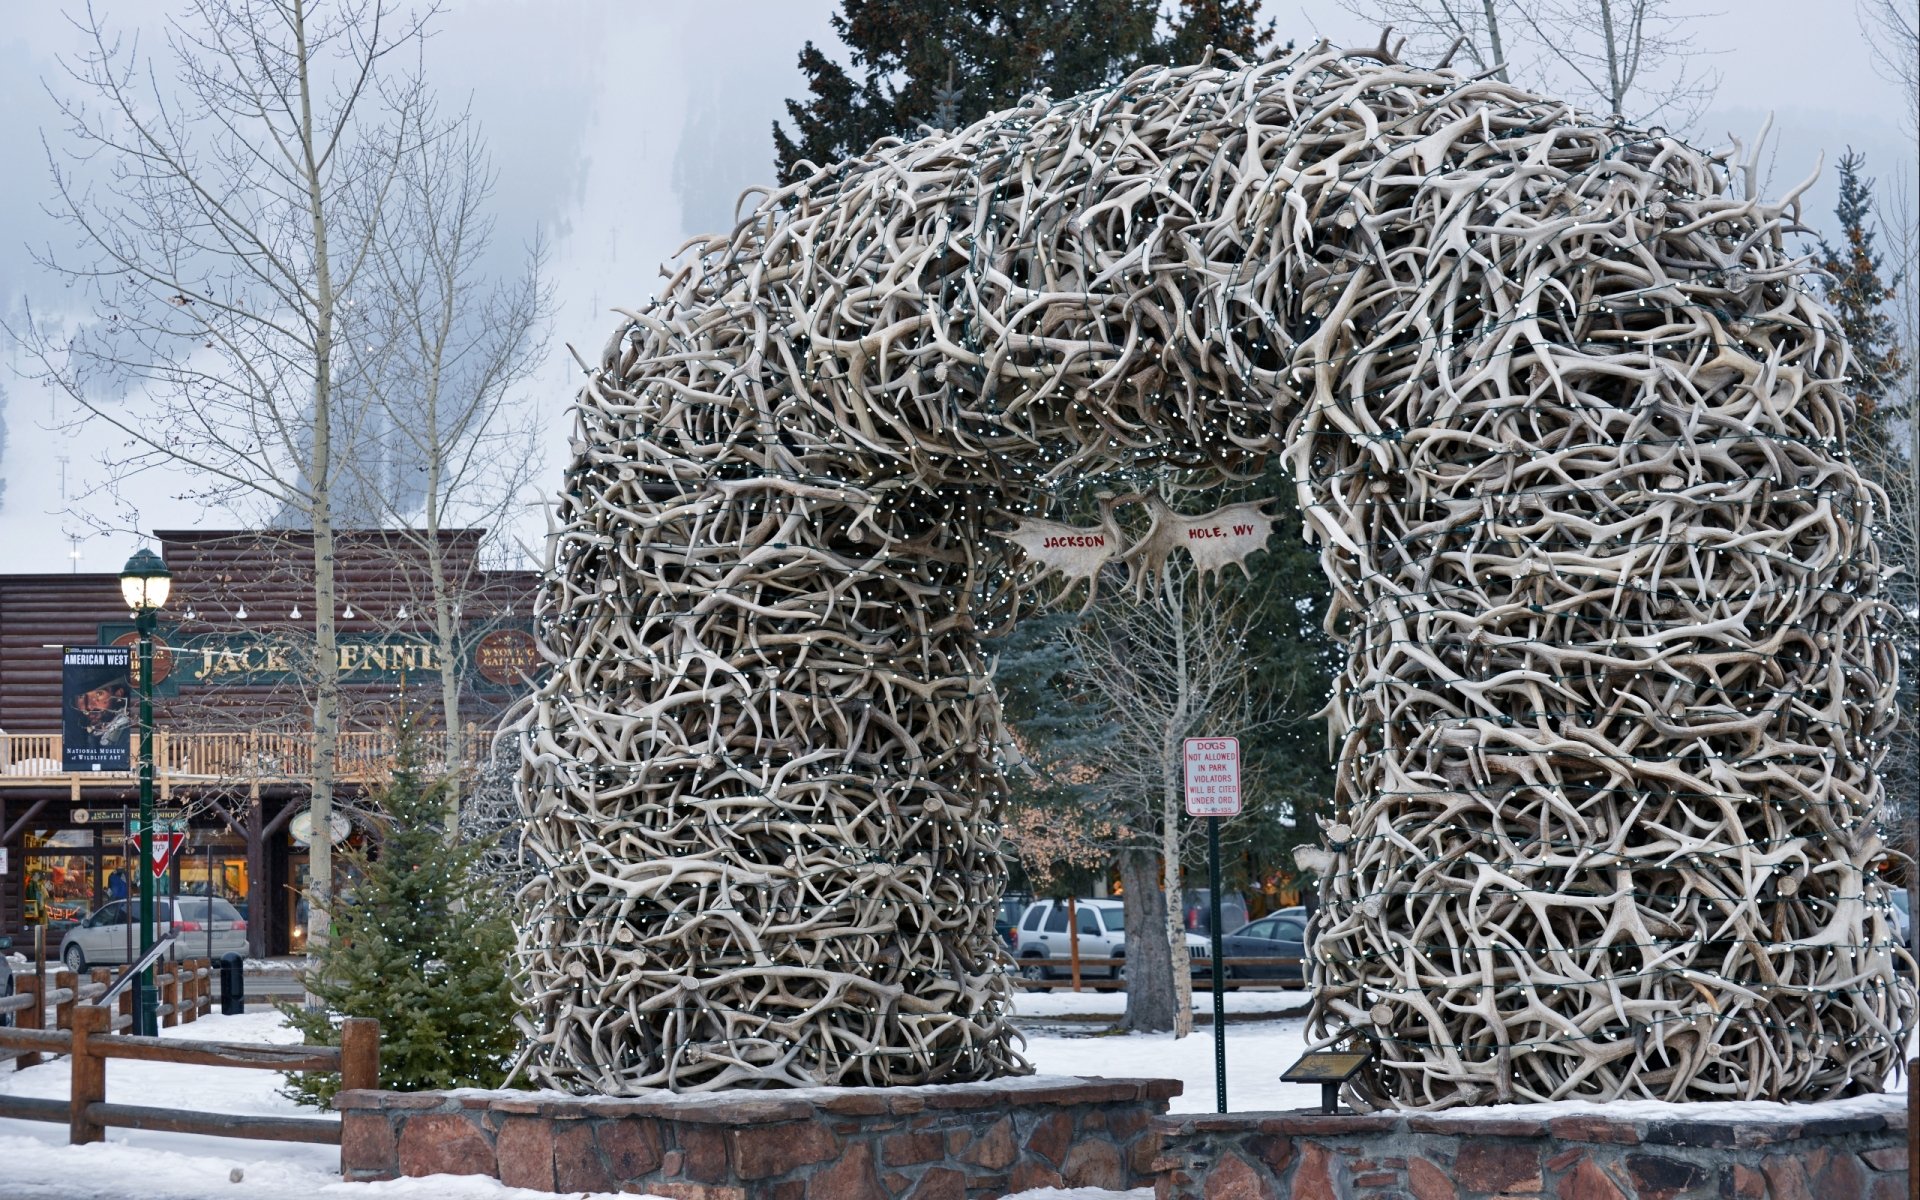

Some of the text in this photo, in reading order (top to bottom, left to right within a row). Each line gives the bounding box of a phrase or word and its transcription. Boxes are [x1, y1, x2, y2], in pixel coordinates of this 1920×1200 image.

[1043, 535, 1105, 548] JACKSON
[1233, 524, 1255, 536] WY
[64, 654, 105, 665] AMERICAN
[107, 654, 129, 665] WEST
[195, 644, 442, 678] JACK ENNI
[1197, 742, 1226, 750] DOGS
[1188, 752, 1236, 761] NOT ALLOWED
[1198, 764, 1206, 772] IN
[1194, 774, 1232, 783] VIOLATORS
[1218, 785, 1237, 793] CITED
